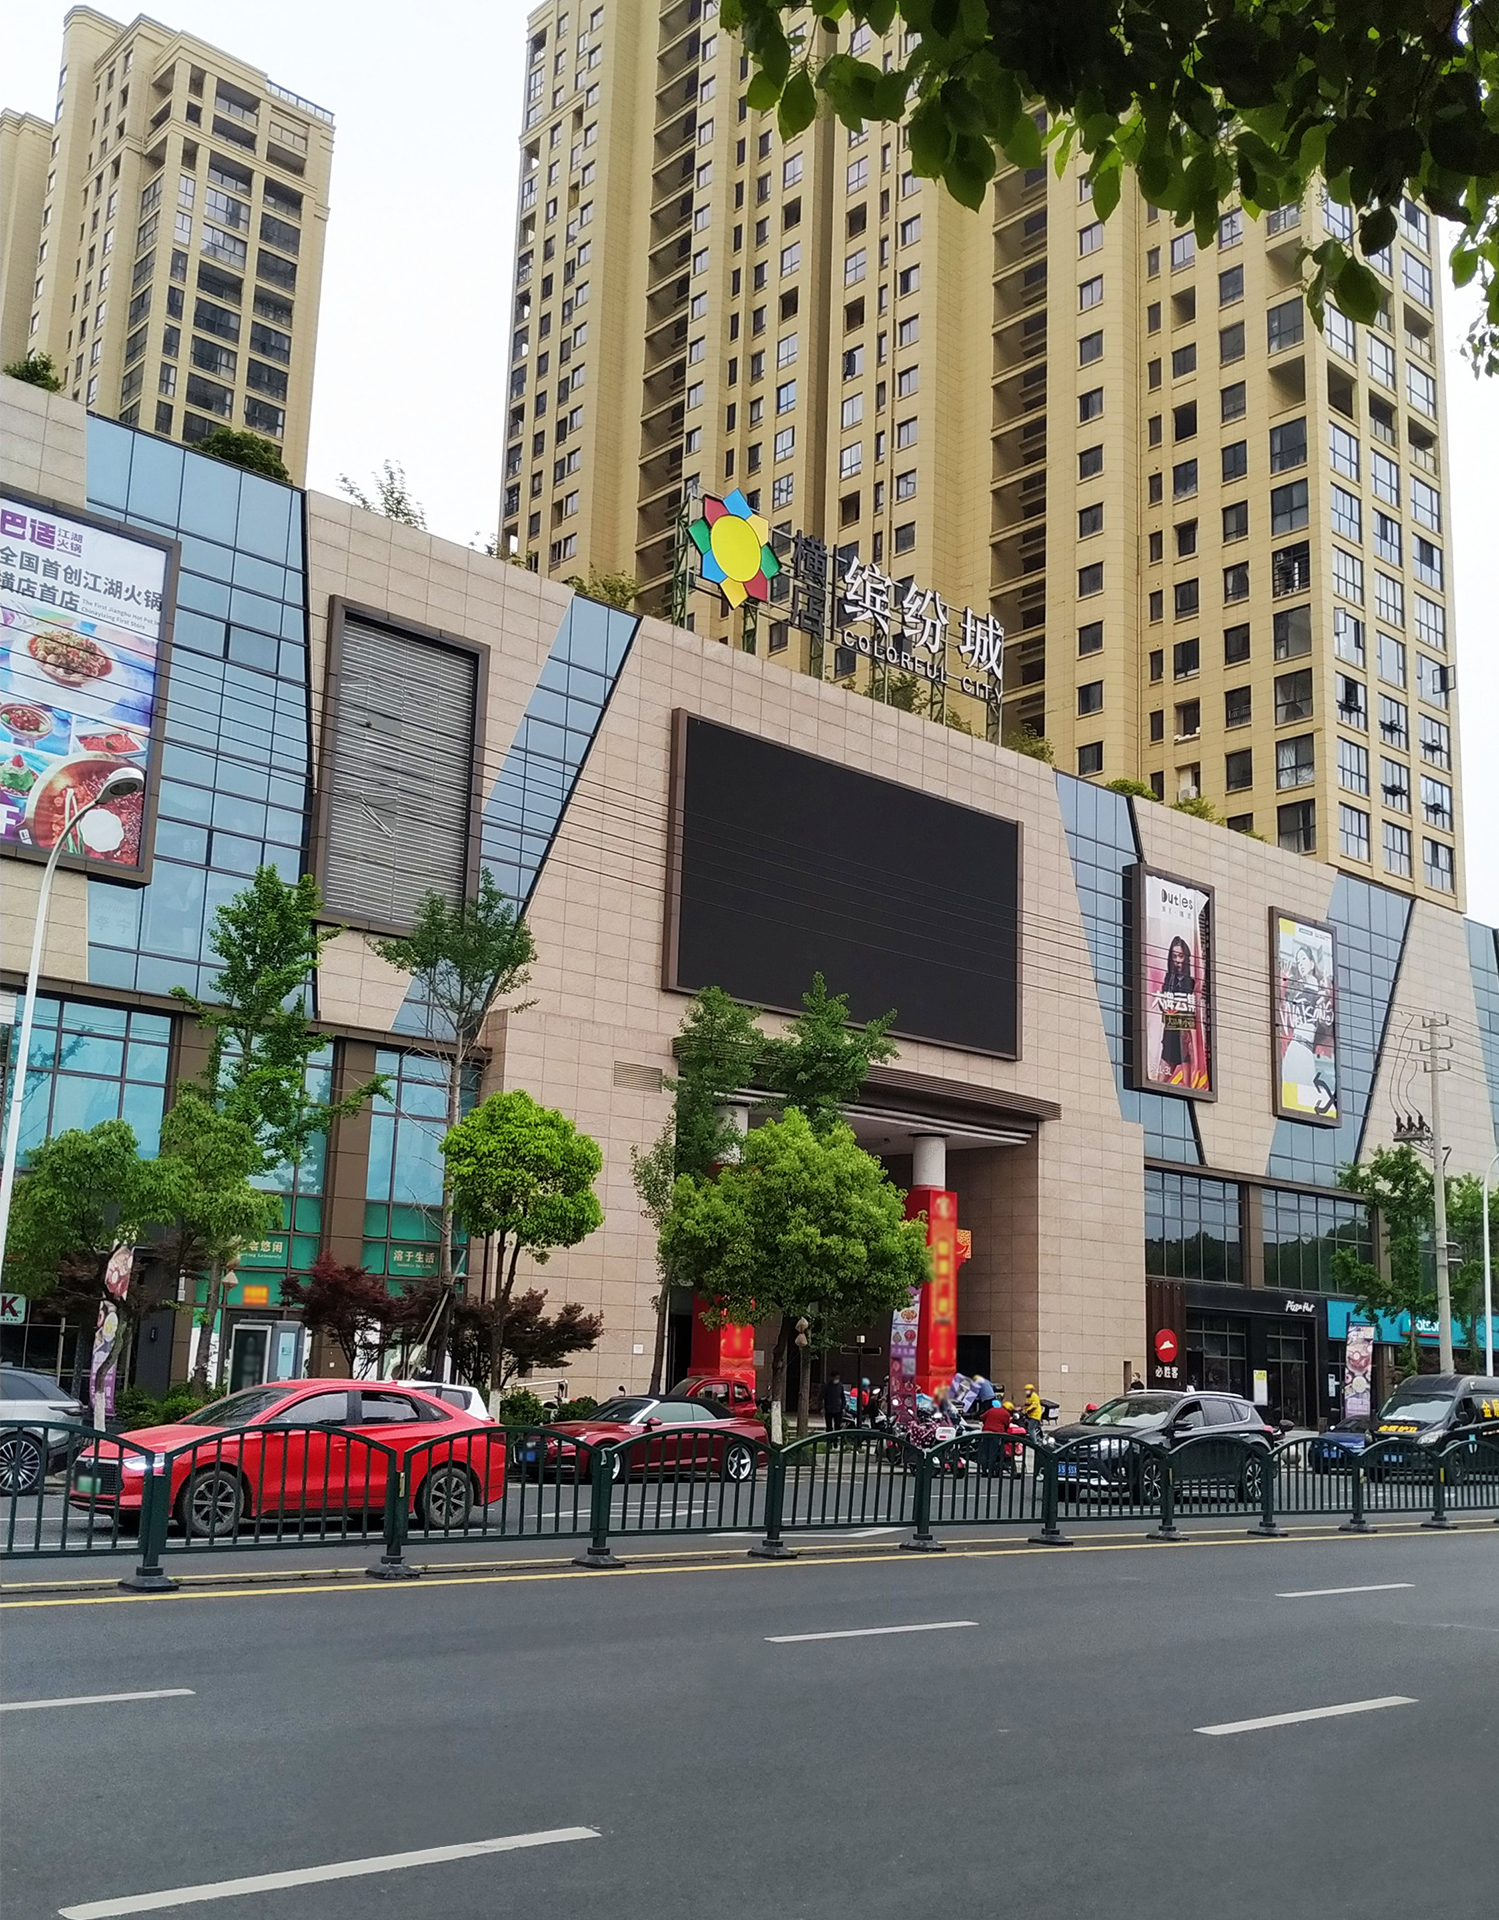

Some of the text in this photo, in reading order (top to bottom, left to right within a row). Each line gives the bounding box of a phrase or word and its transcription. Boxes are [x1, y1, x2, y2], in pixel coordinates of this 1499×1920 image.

[1, 509, 56, 550] 巴适
[57, 539, 82, 554] 火锅
[58, 528, 83, 543] 江湖
[0, 546, 163, 612] 全国首创江湖火锅
[790, 530, 827, 638] 横店
[82, 598, 93, 607] The
[94, 602, 107, 611] First
[108, 605, 132, 618] Jianghu
[132, 614, 143, 622] Hot
[143, 617, 154, 625] Pot
[116, 617, 130, 626] First
[130, 620, 146, 630] Store
[843, 556, 1004, 680] 缤纷城
[843, 629, 1005, 702] COLORFUL CITY
[1155, 1366, 1178, 1379] 必胜客
